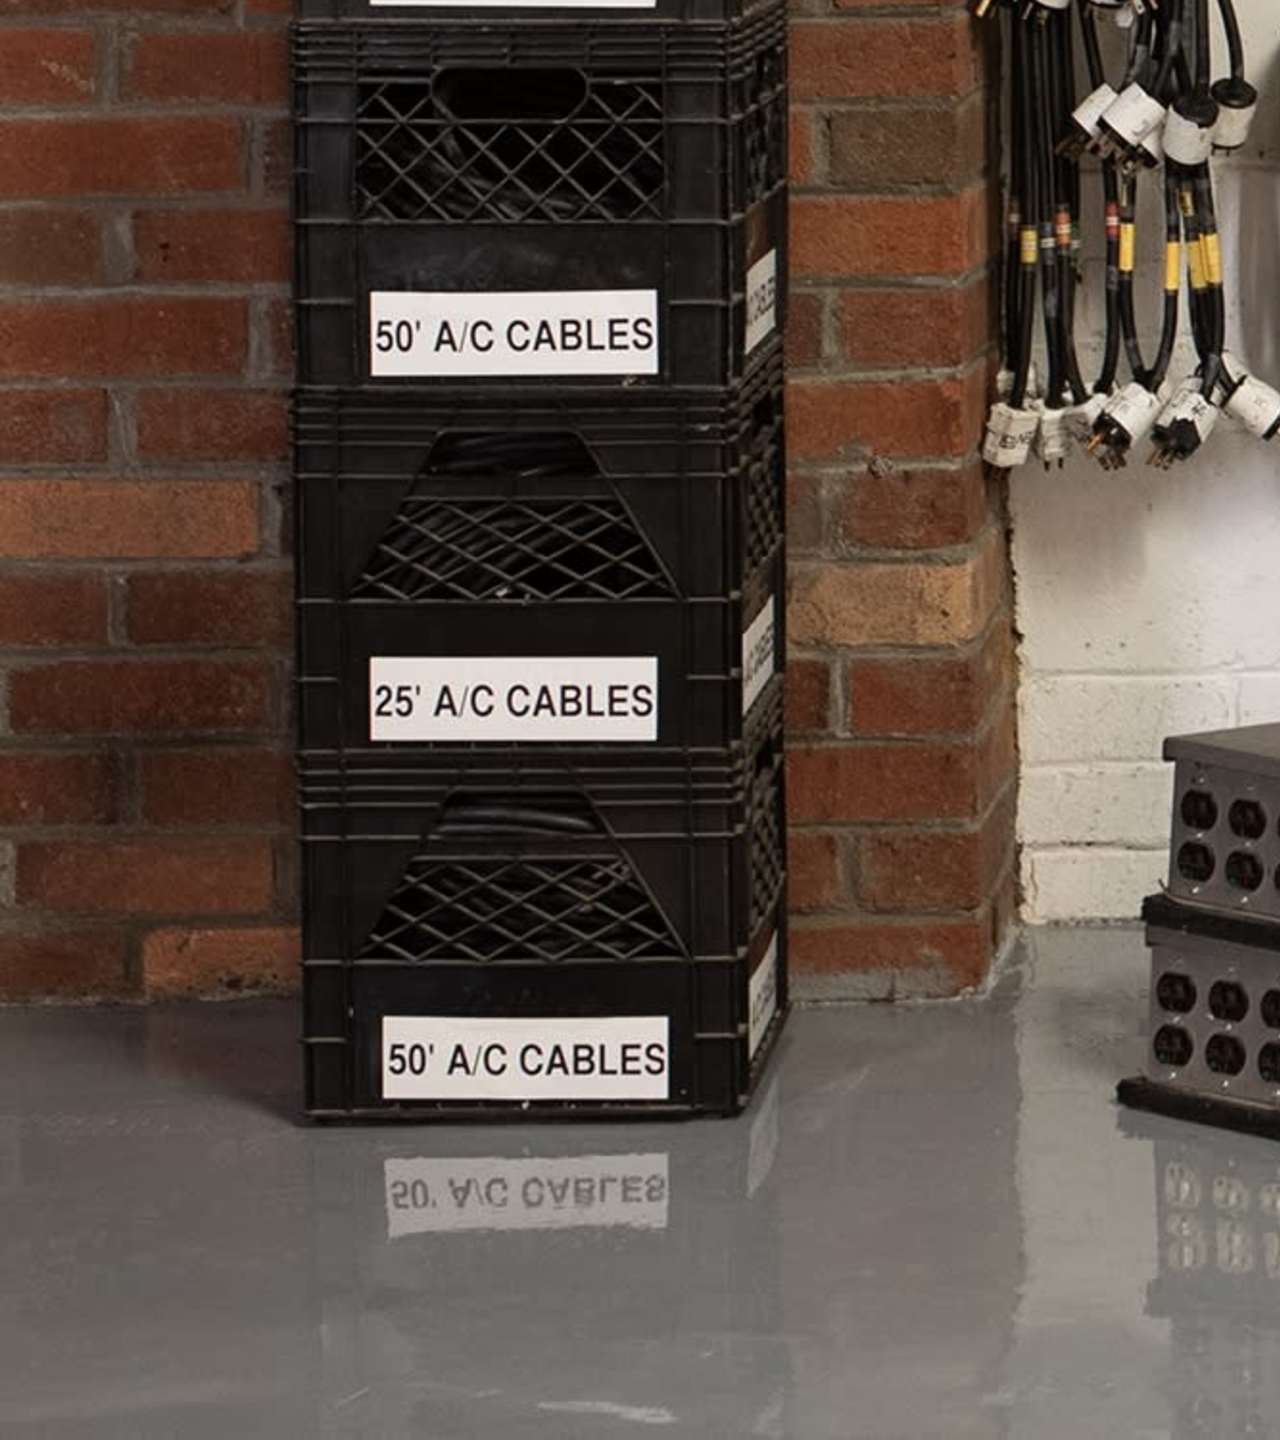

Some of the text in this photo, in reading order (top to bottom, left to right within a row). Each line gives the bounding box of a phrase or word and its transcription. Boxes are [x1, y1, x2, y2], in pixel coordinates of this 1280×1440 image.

[375, 319, 654, 353] 50' A/C CABLES
[373, 685, 655, 717] 25' A/C CABLES
[387, 1043, 666, 1076] 50' A/C CABLES
